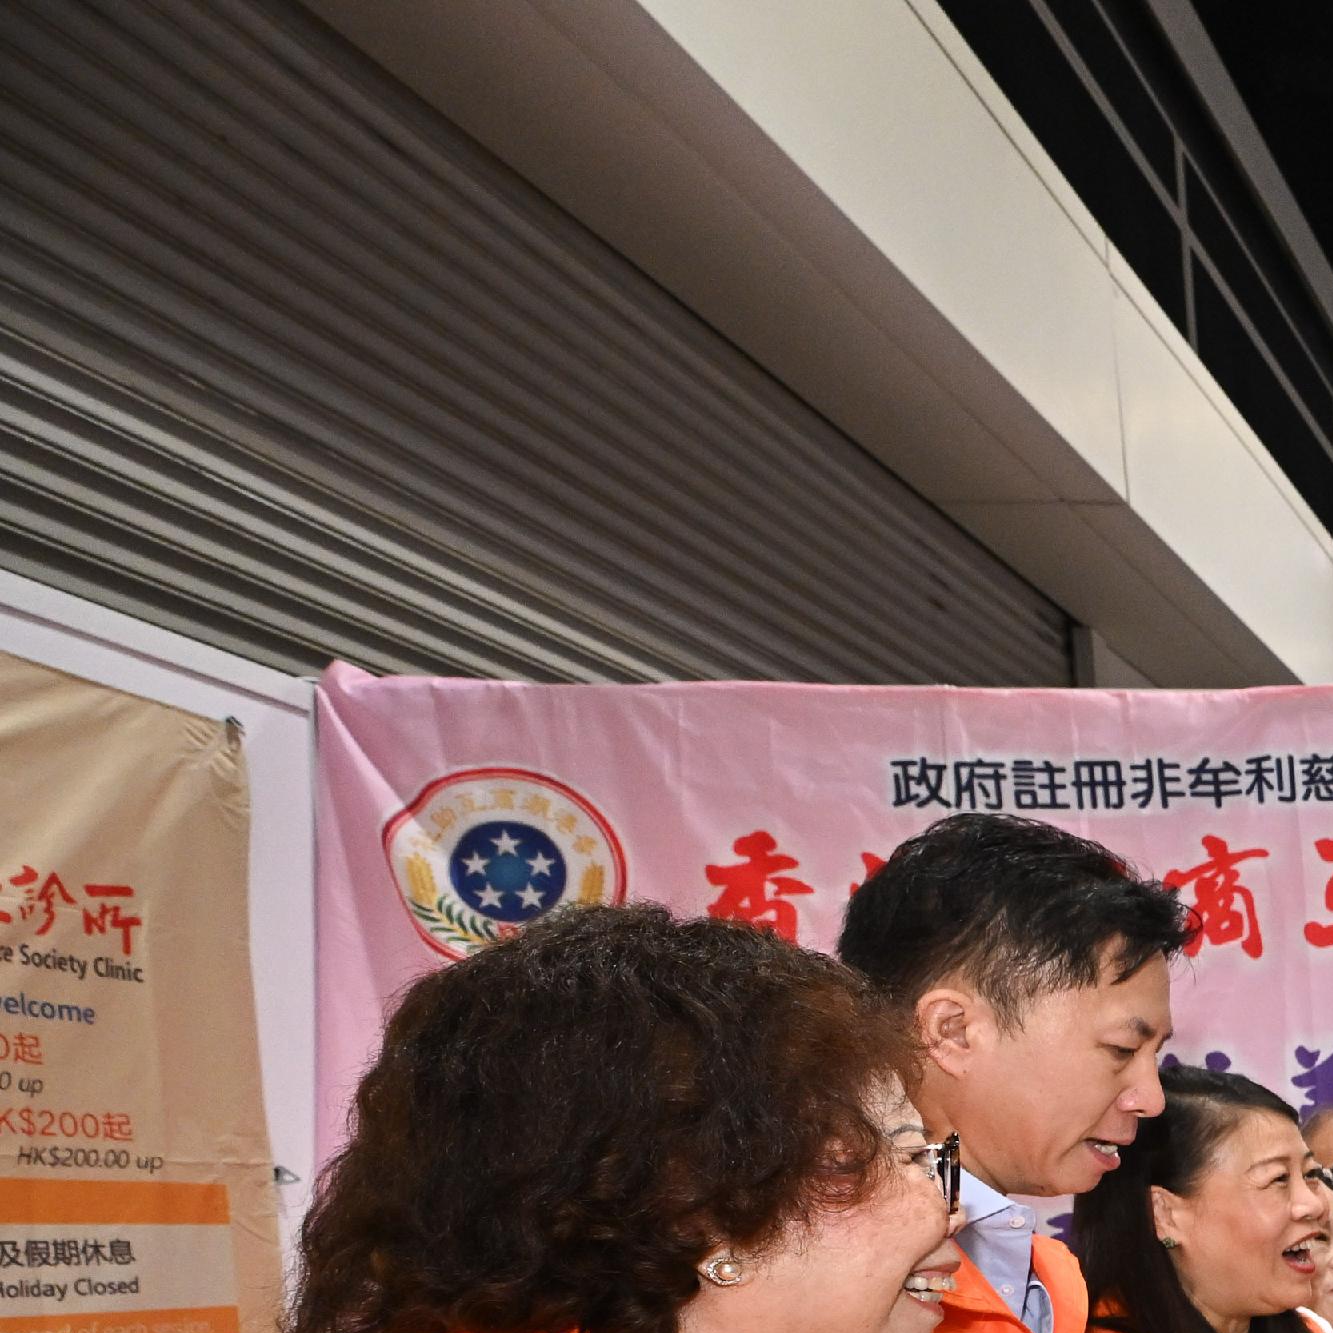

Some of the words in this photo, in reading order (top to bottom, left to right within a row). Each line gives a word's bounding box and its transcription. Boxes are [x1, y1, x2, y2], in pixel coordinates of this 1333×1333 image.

[0, 864, 141, 956] 診所
[20, 944, 88, 980] Society
[93, 957, 145, 984] Clinic
[18, 1077, 44, 1098] up
[17, 1145, 131, 1170] HK$200.00
[136, 1153, 164, 1174] up
[0, 1239, 137, 1268] 及假期休息
[74, 1276, 140, 1298] Closed
